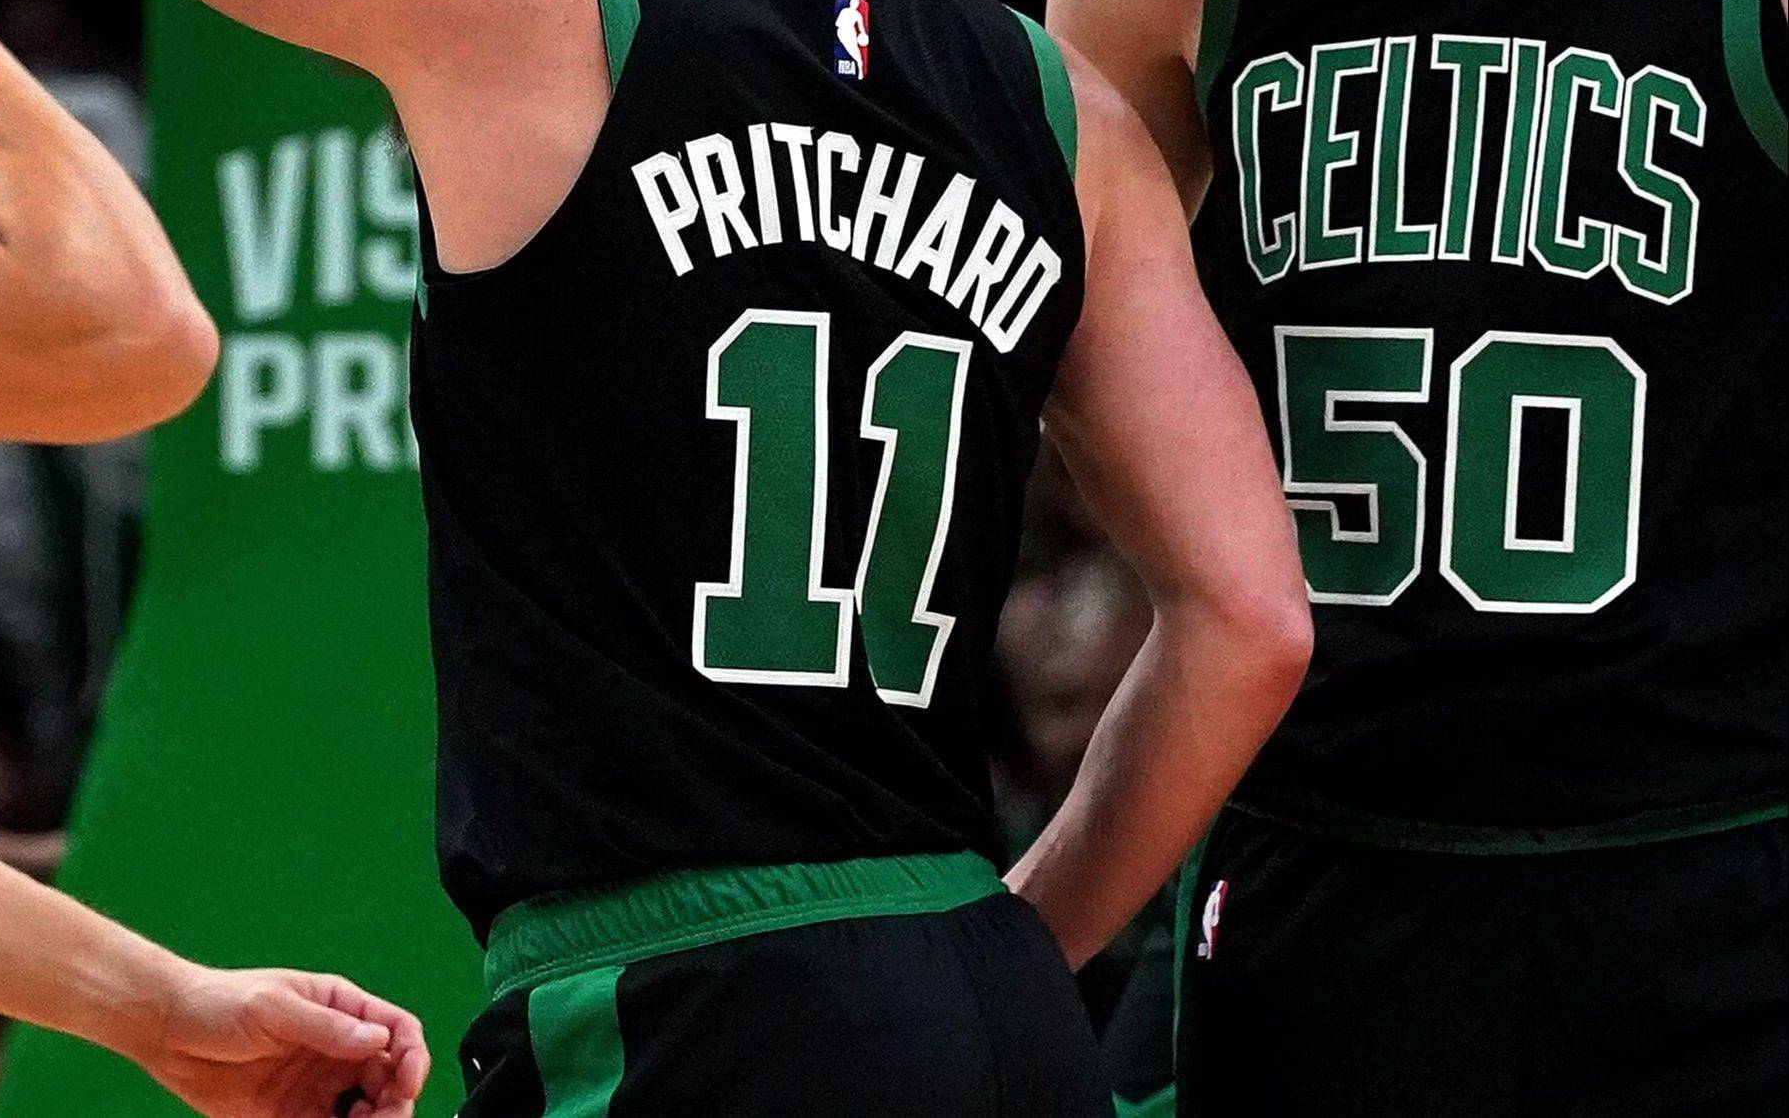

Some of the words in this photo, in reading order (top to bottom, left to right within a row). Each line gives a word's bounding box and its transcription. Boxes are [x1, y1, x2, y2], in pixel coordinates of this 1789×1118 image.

[631, 122, 1062, 354] PRITCHARD
[1231, 34, 1708, 306] CELTICS
[219, 331, 419, 474] PR
[691, 307, 973, 709] 11
[1273, 325, 1648, 614] 50
